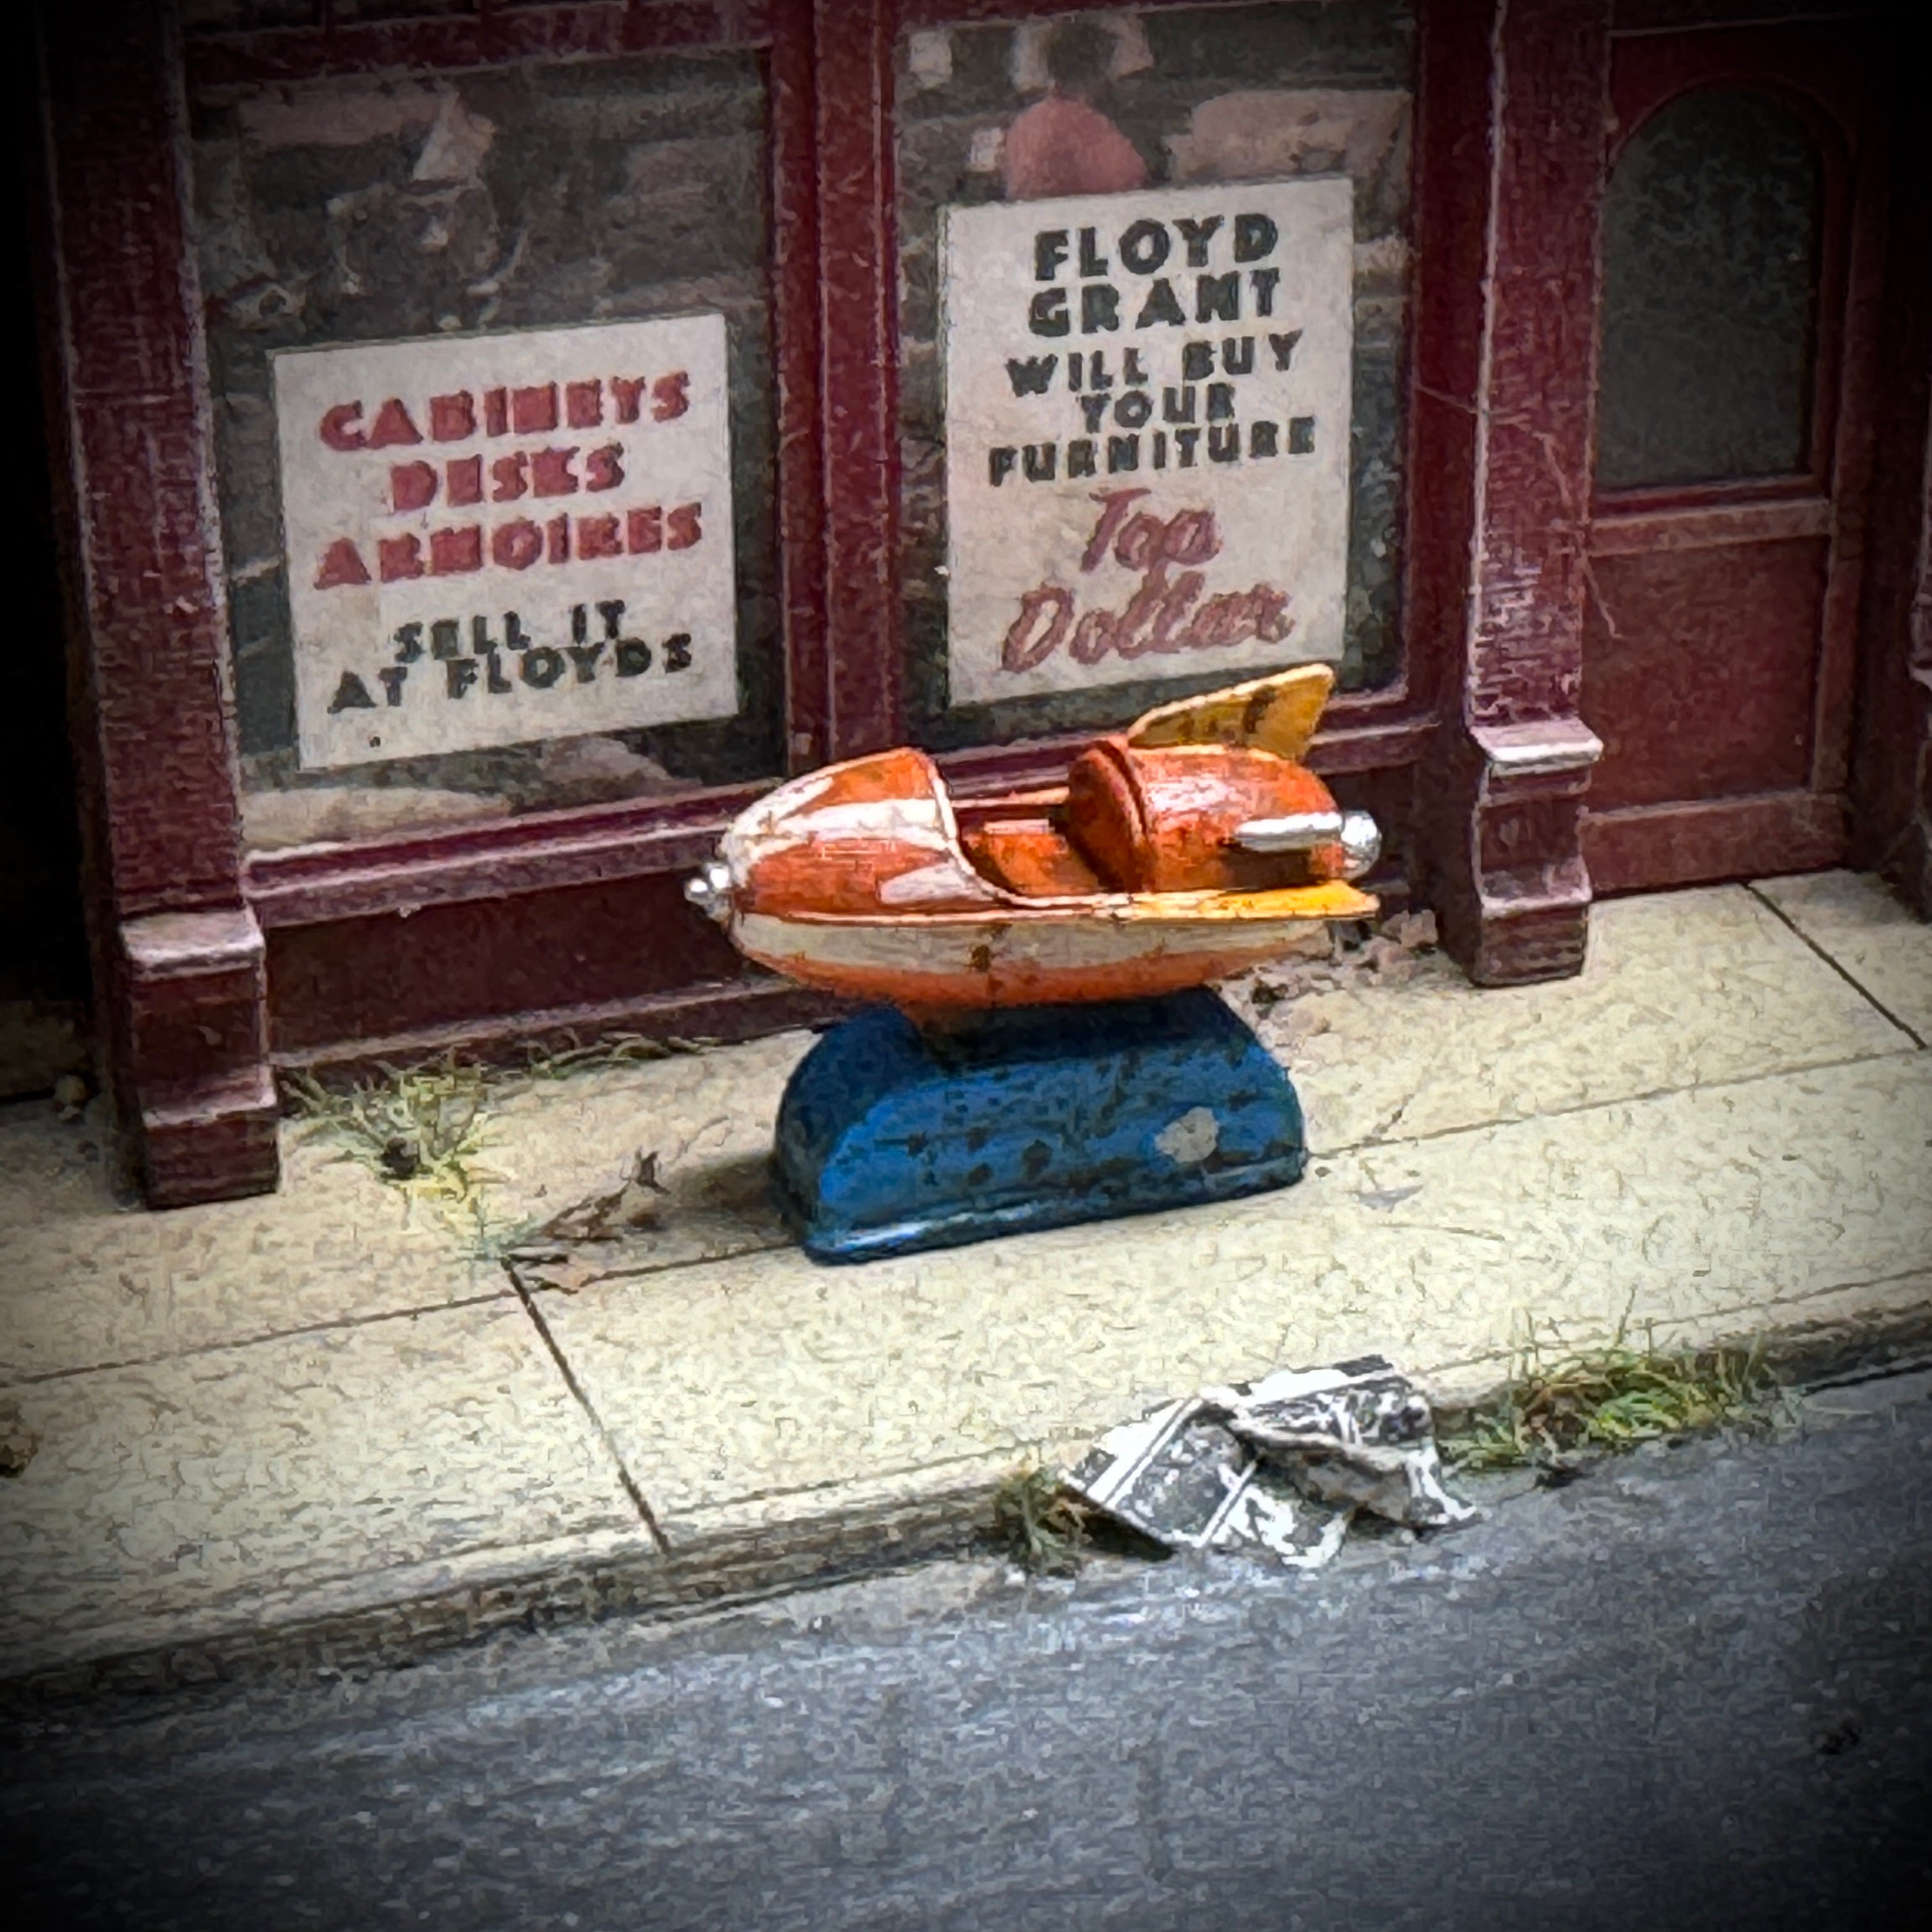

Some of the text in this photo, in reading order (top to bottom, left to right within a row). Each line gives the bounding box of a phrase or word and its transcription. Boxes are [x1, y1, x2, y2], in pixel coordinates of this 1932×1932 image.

[1034, 212, 1278, 282] FLOYD
[1028, 267, 1280, 337] GRANT
[1005, 329, 1303, 397] WILL BUY
[1077, 382, 1236, 434] YOUR
[988, 415, 1315, 487] FURNITURE
[1080, 486, 1225, 578] Top
[393, 599, 626, 663] SELL IT
[1000, 570, 1297, 673] Dollar
[326, 632, 693, 714] AT FLOYDS
